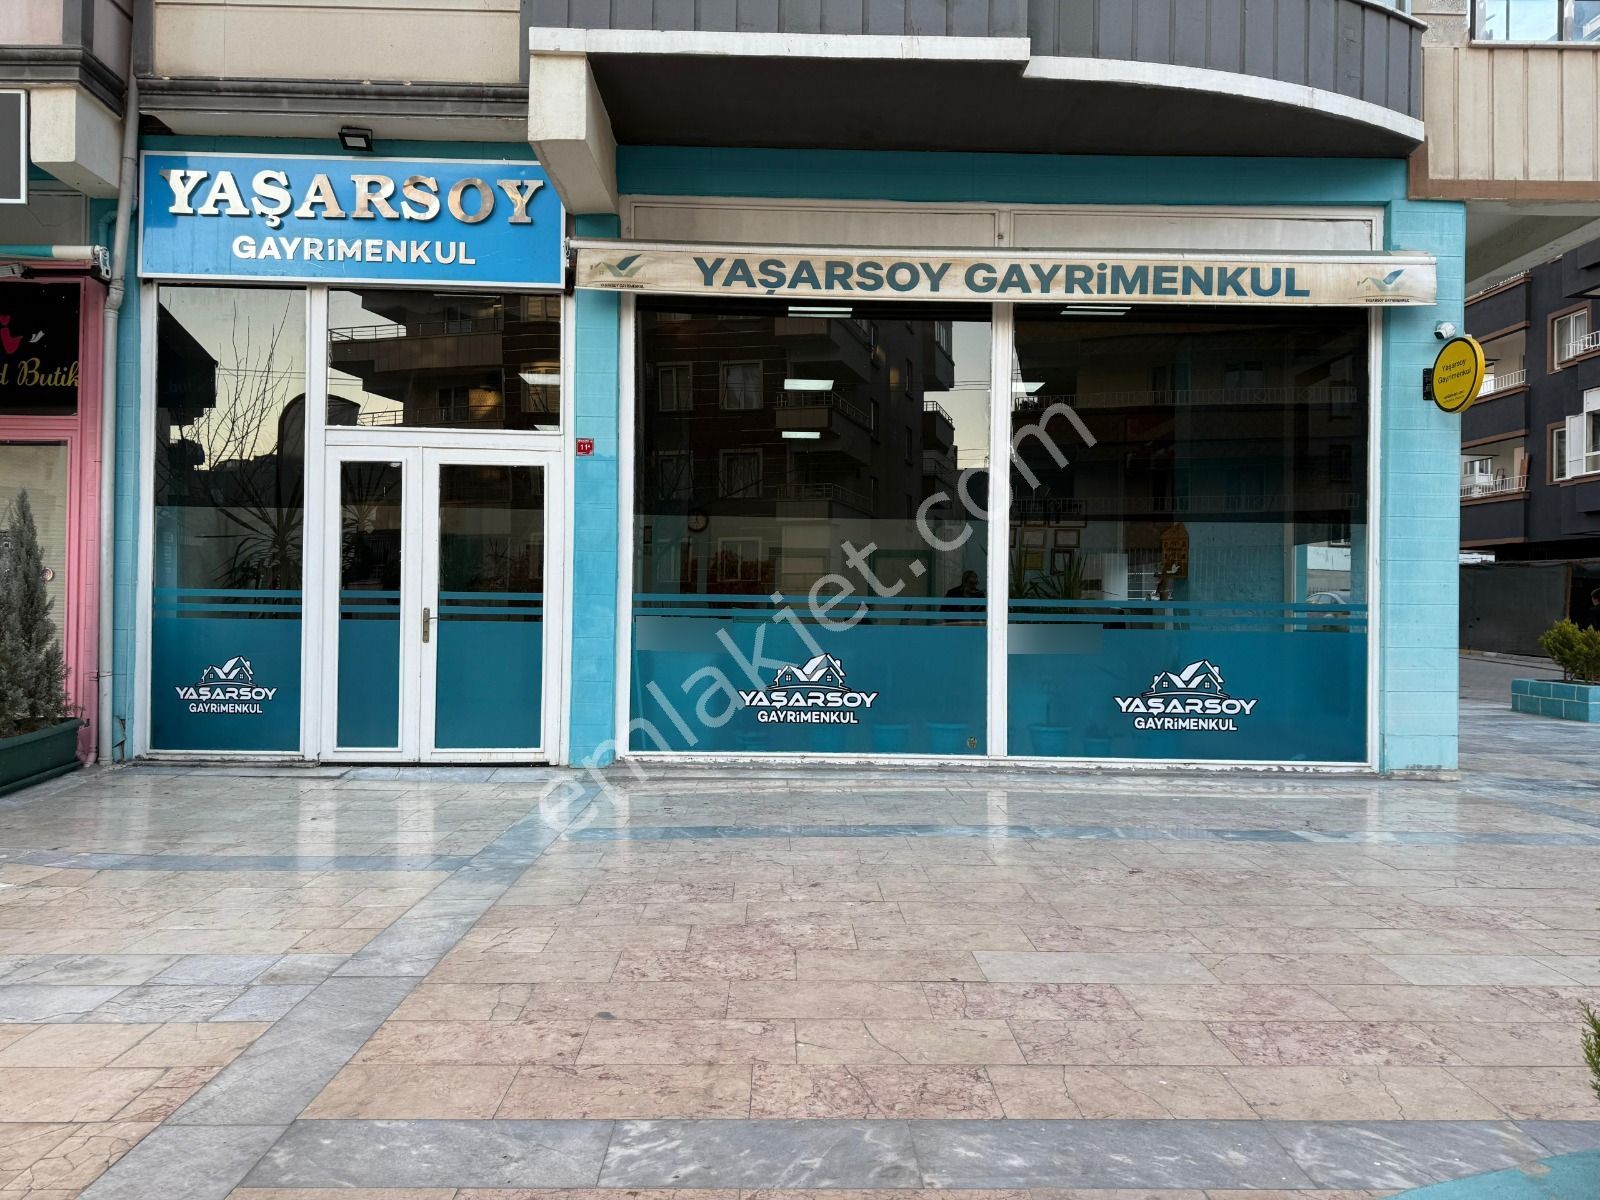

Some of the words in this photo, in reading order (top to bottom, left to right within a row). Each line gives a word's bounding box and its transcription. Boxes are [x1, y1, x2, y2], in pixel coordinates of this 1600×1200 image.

[161, 168, 545, 228] YAŞARSOY
[692, 257, 953, 296] YAŞARSOY
[175, 686, 278, 702] YAŞARSOY
[738, 690, 879, 709] YAŞARSOY
[1114, 695, 1258, 716] YAŞARSOY
